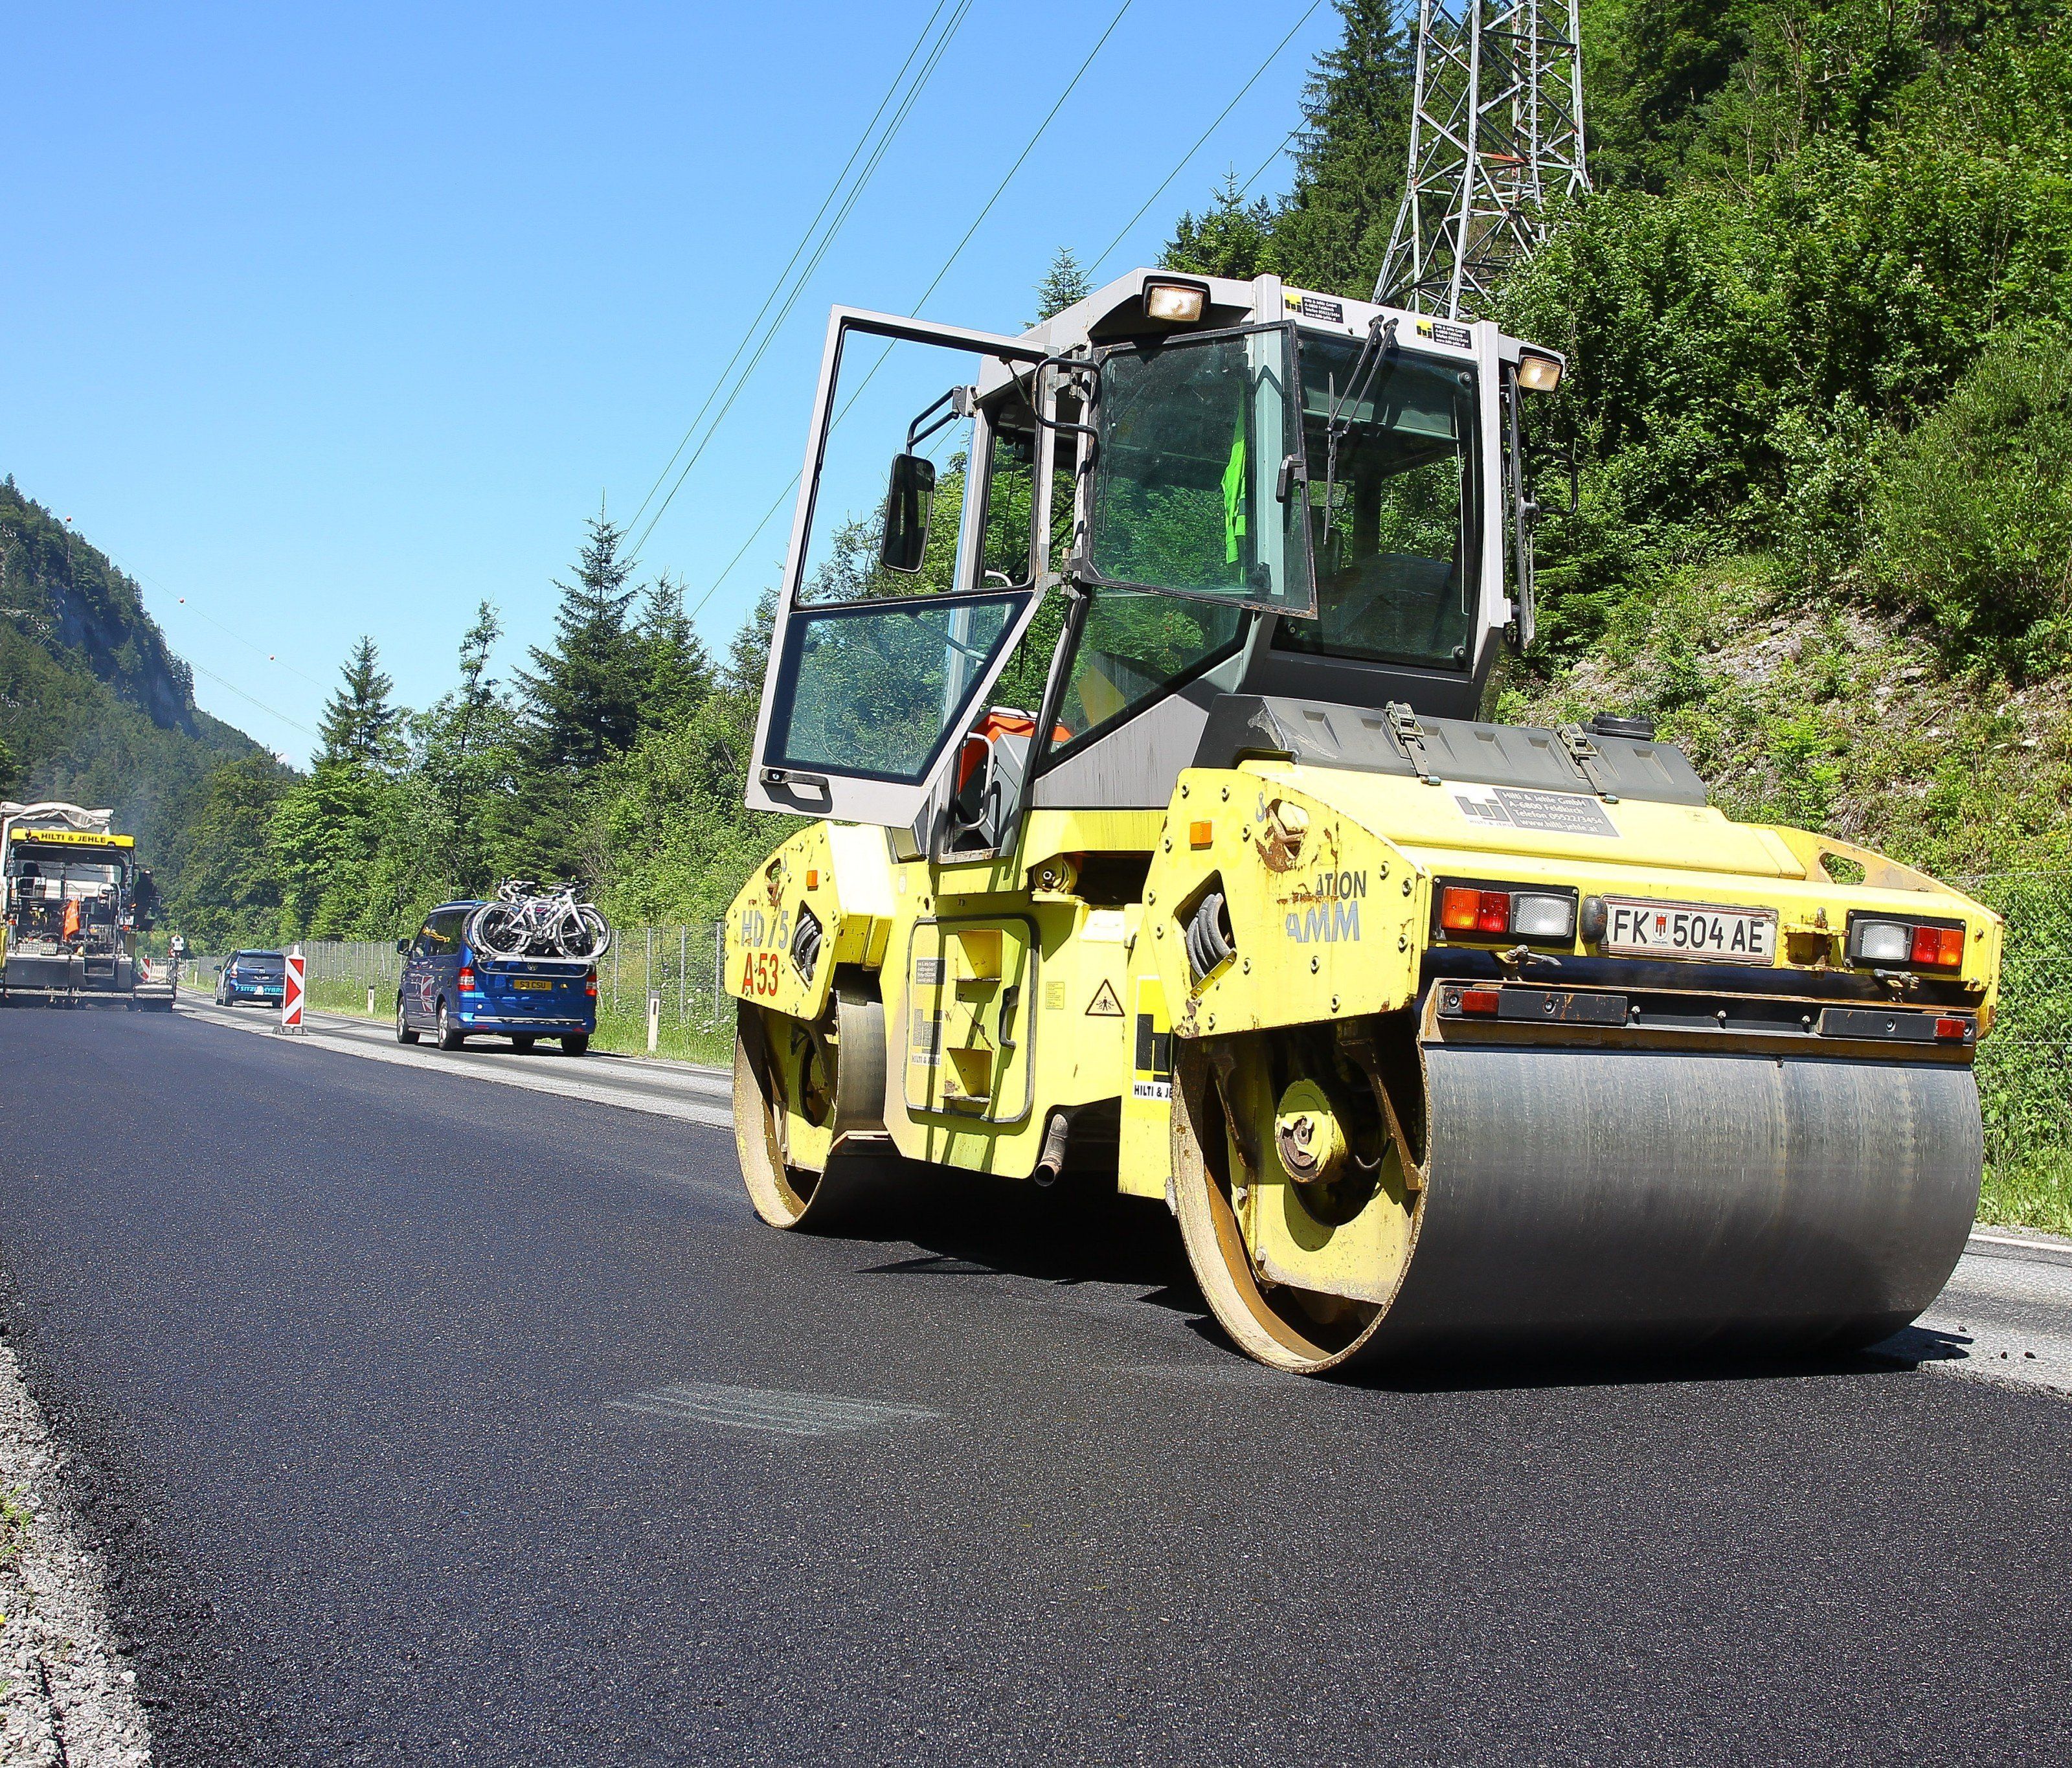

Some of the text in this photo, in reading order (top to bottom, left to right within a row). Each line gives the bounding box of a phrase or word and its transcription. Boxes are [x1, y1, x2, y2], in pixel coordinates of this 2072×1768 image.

[1502, 791, 1522, 800] Hilti
[1534, 795, 1557, 804] Jehle
[1559, 797, 1588, 807] GmbH
[1509, 800, 1584, 815] A-6800 Feldkirch
[1512, 809, 1604, 825] Telefon 05522/3454
[1520, 819, 1599, 833] www.hilti-jehle.at
[741, 910, 765, 947] HD
[1614, 909, 1764, 953] FK 504 AE
[1134, 1085, 1154, 1097] HILTI
[1156, 1087, 1162, 1097] &
